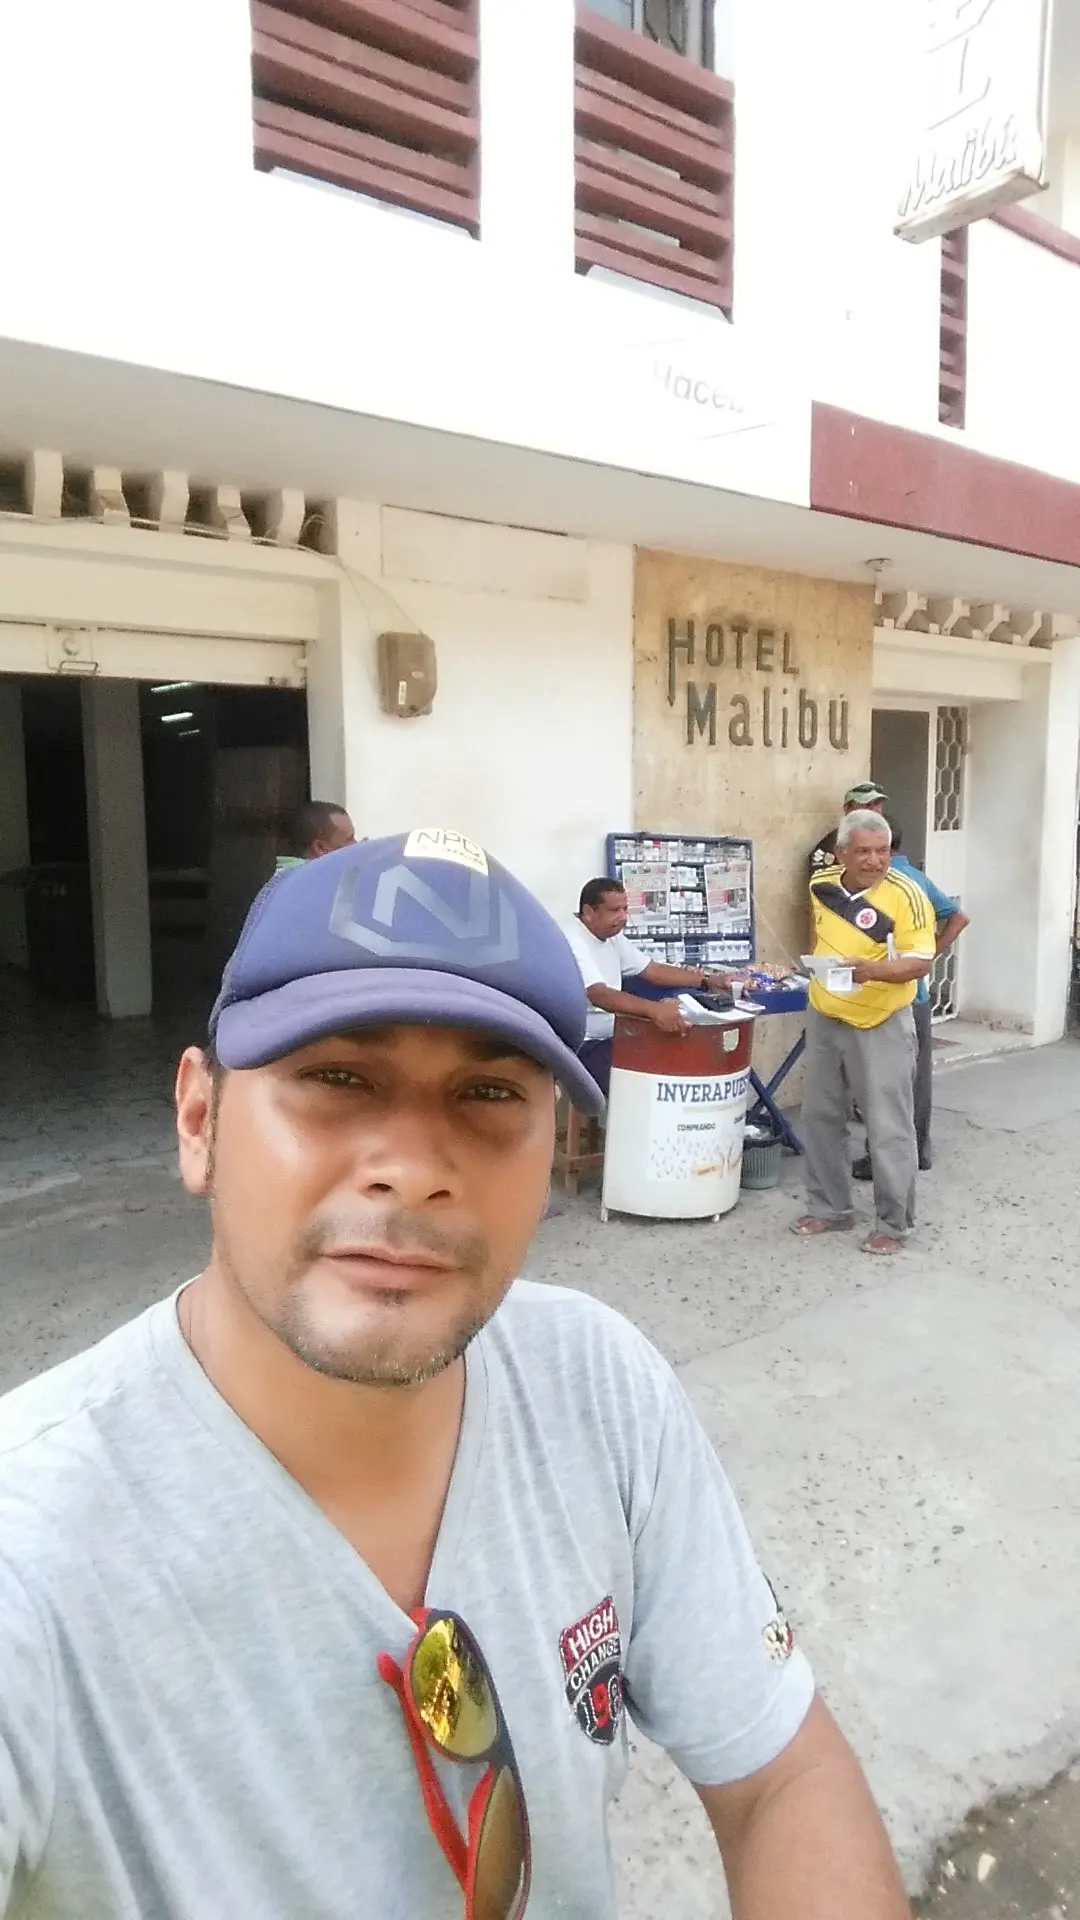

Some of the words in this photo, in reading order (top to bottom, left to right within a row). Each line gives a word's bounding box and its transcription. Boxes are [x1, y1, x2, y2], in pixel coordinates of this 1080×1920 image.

[667, 617, 800, 708] HOTEL
[568, 1606, 614, 1660] HIGH
[570, 1637, 620, 1690] CHANGE
